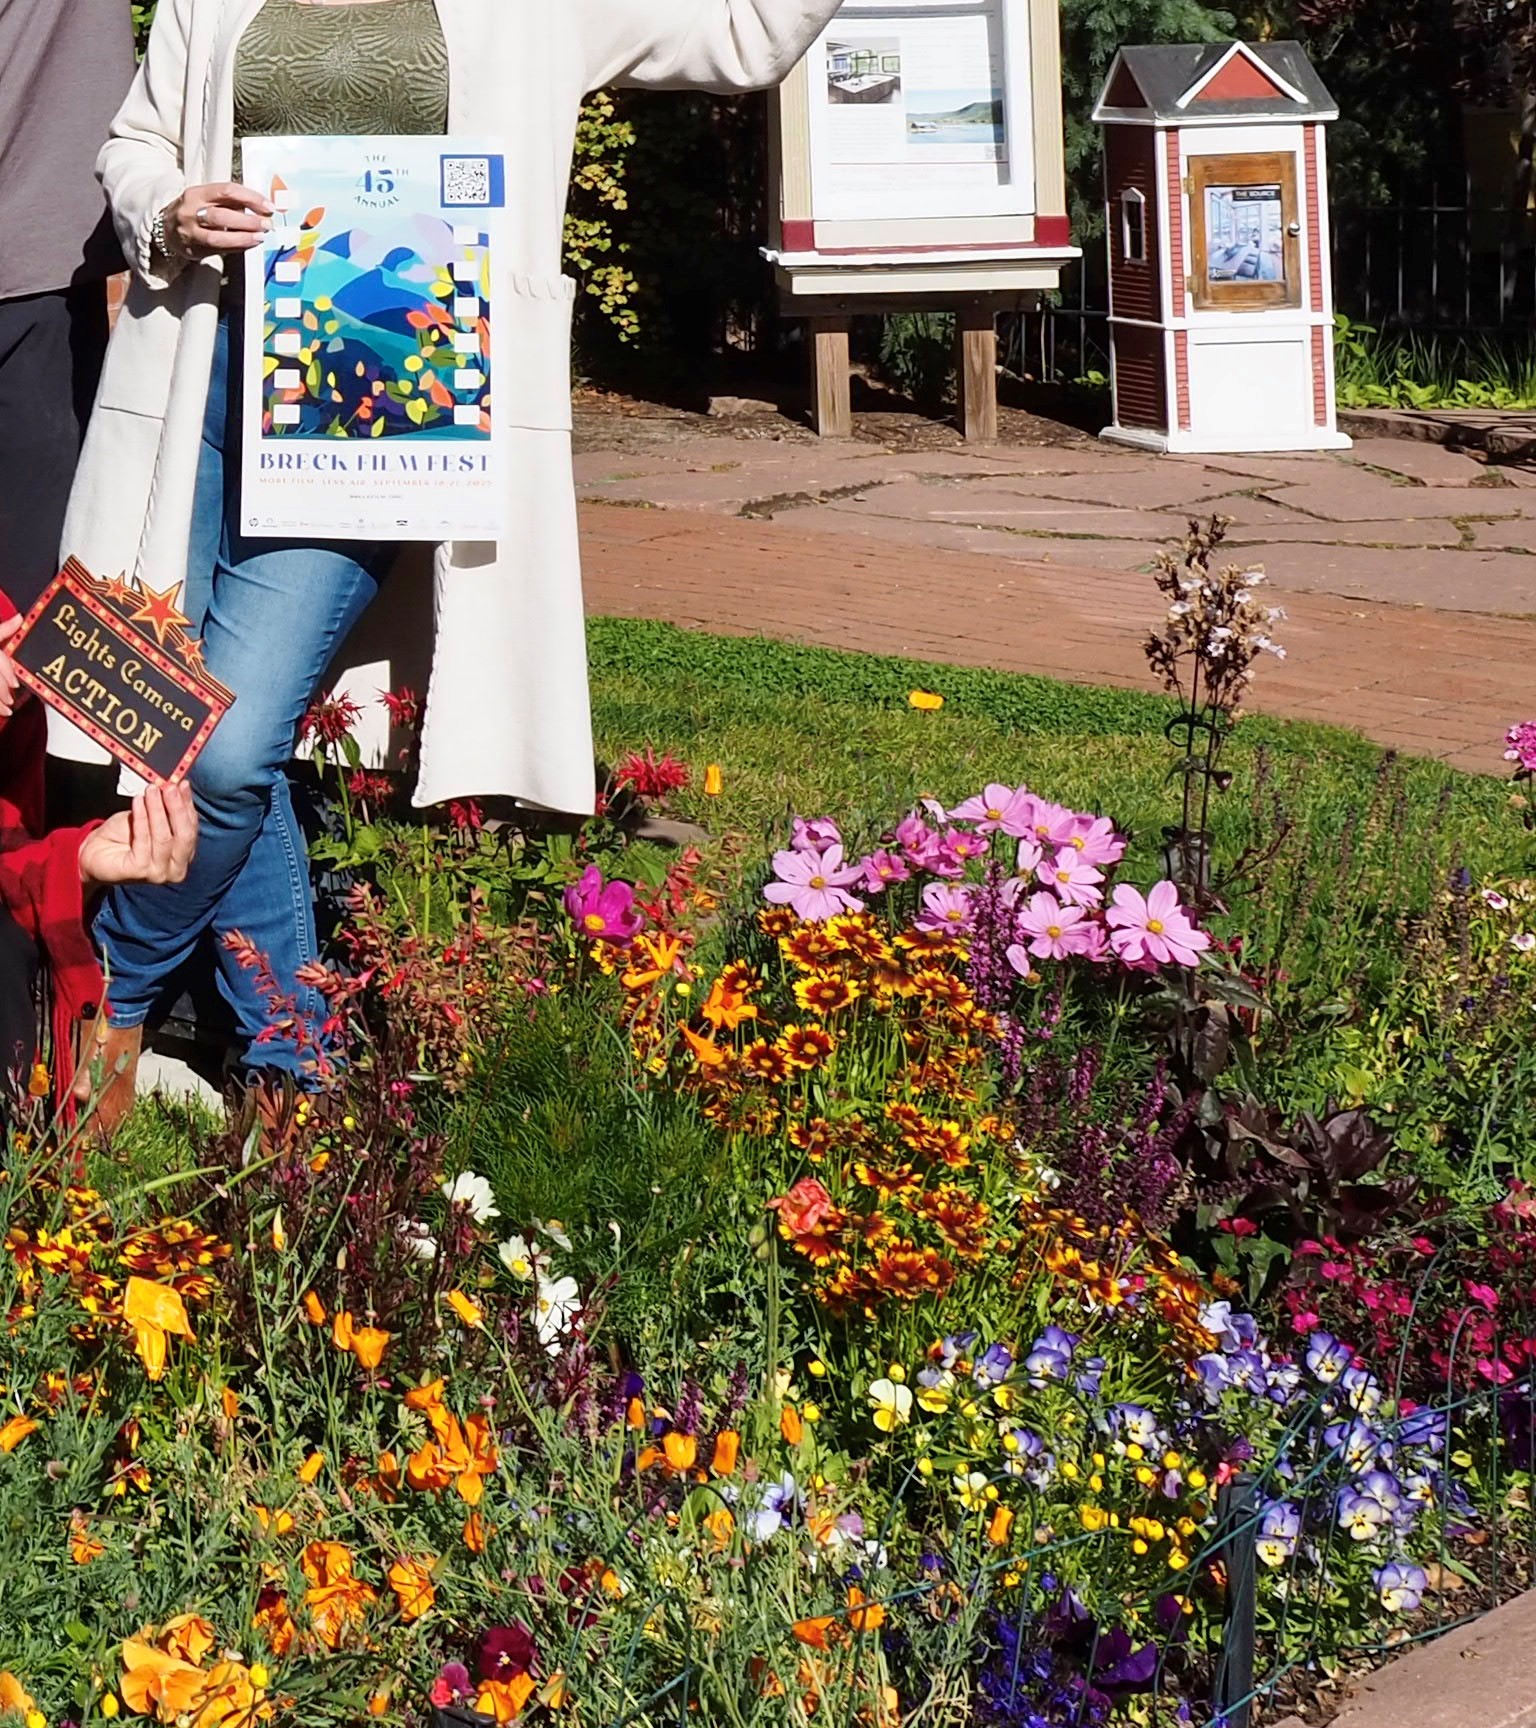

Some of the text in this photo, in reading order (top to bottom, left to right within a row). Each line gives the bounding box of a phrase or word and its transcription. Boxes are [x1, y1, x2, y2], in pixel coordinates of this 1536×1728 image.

[355, 195, 400, 208] ANNUAL
[260, 453, 492, 472] BRECK FILM FEST
[53, 604, 194, 732] Lights Camera
[42, 654, 163, 754] ACTION
